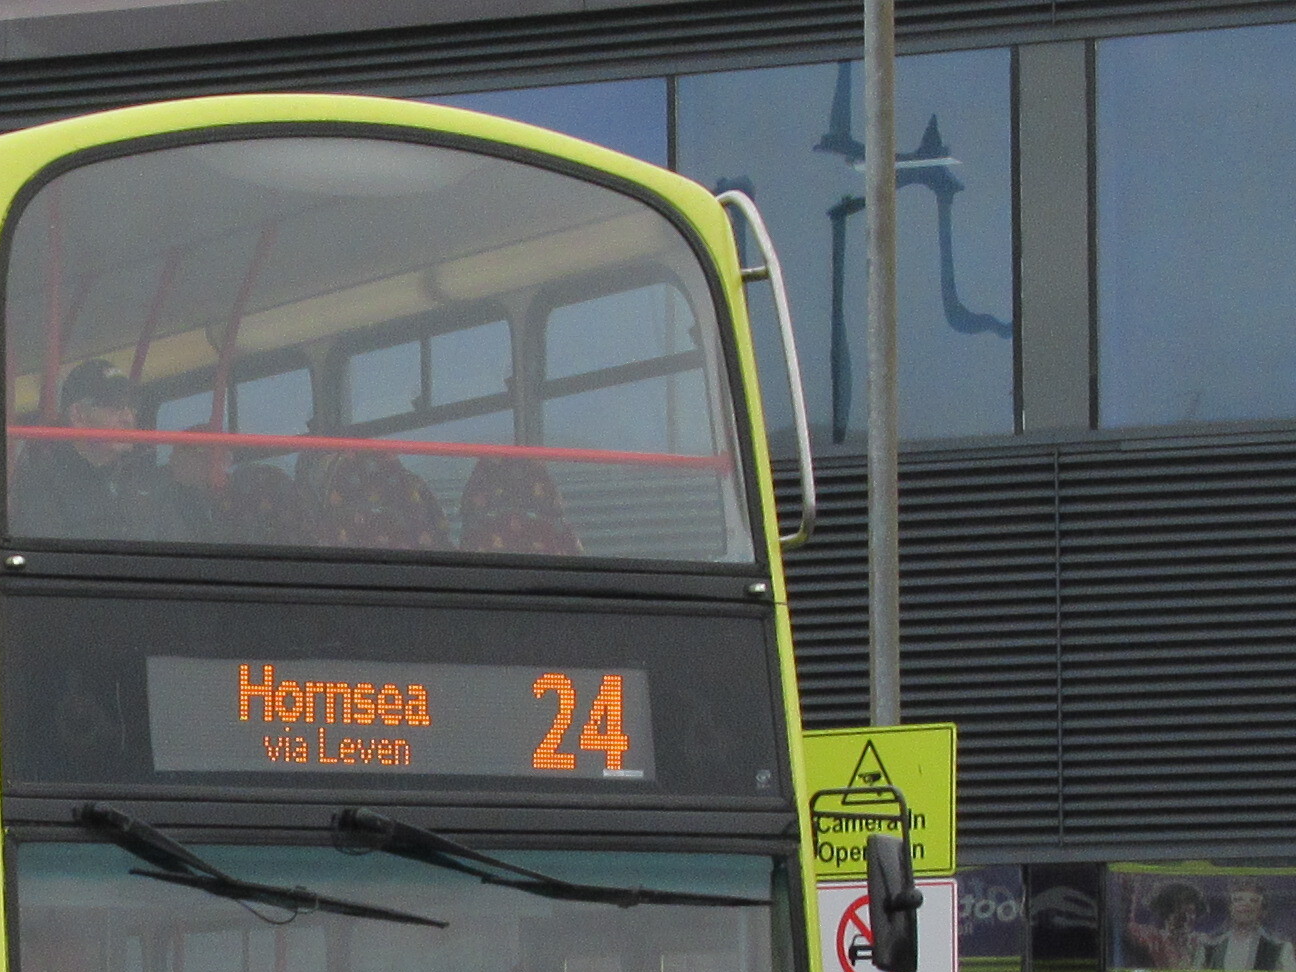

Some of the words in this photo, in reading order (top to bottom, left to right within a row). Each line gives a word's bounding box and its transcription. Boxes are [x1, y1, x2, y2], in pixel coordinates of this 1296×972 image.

[239, 664, 432, 726] Hornsea
[531, 672, 630, 770] 24
[263, 725, 309, 763] via
[317, 726, 411, 766] Leven
